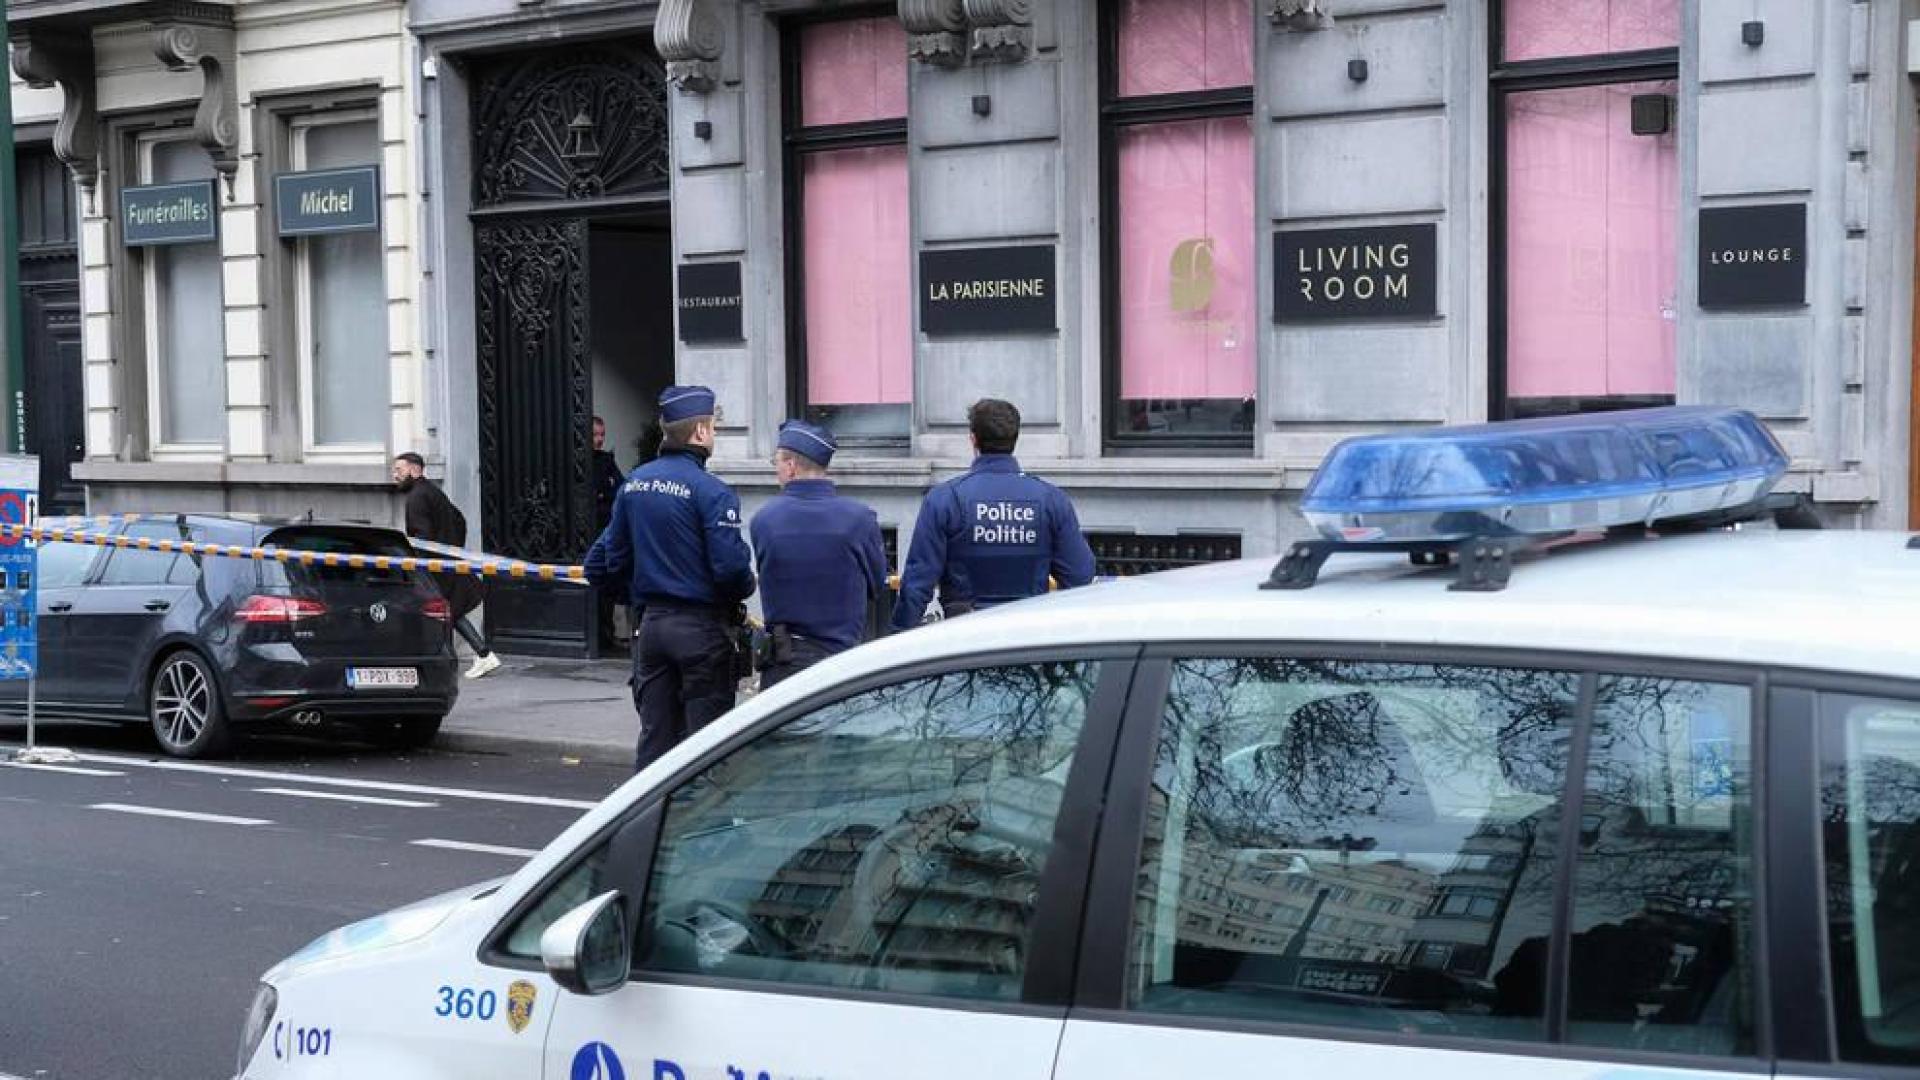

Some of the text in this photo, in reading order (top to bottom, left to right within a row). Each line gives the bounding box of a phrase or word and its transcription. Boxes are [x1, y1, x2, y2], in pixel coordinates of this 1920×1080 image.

[129, 197, 208, 224] Funérailles
[301, 186, 353, 215] Michel
[1299, 243, 1409, 271] LIVING
[1711, 247, 1791, 264] LOUNGE
[930, 279, 1043, 299] LA PARISIENNE
[1300, 273, 1407, 301] ROOM
[651, 480, 692, 499] Politie
[976, 501, 1035, 520] Police
[974, 524, 1037, 543] Politie
[435, 985, 496, 1020] 360
[297, 1026, 331, 1055] 101
